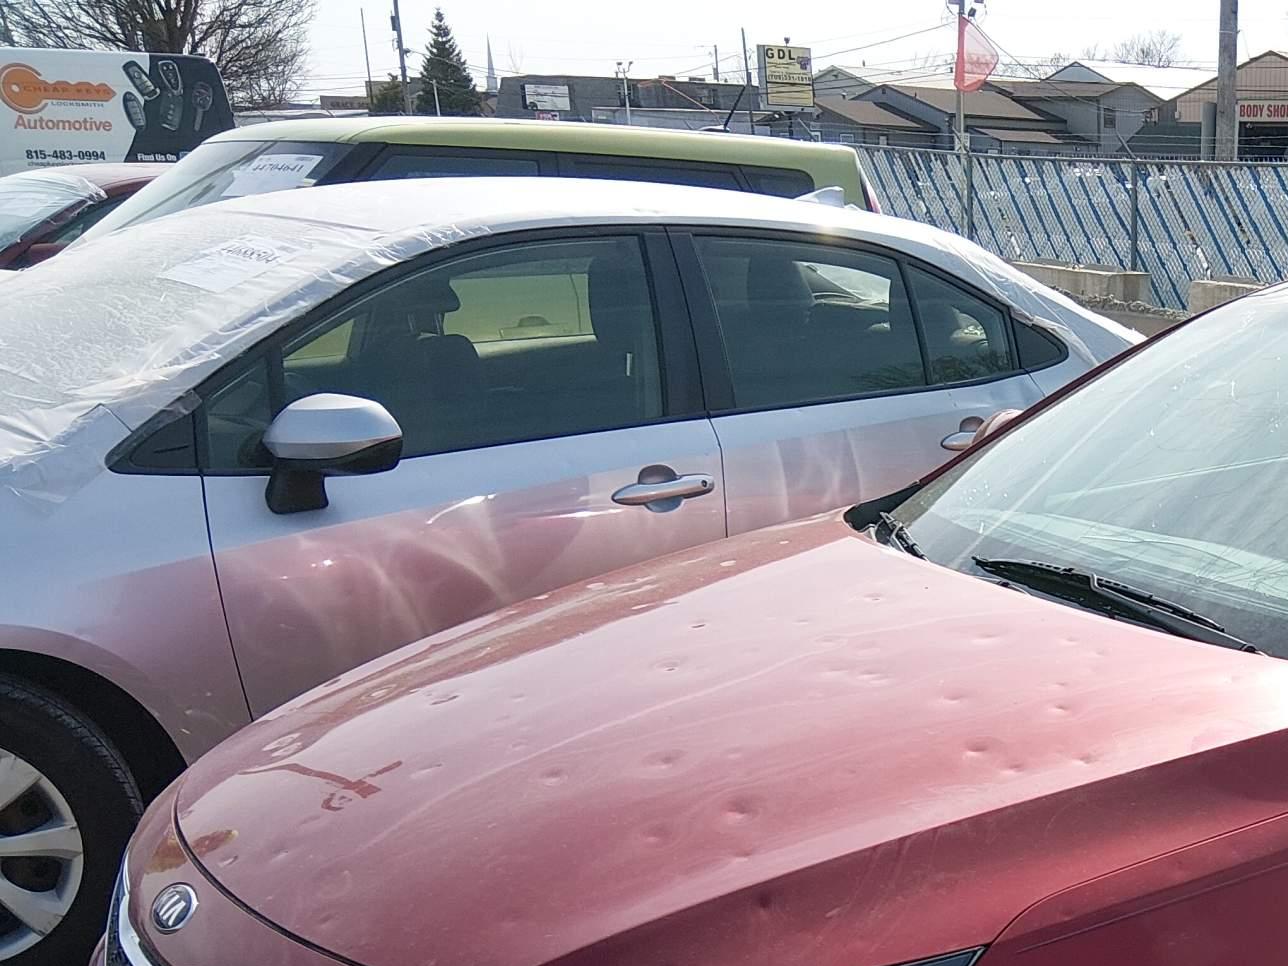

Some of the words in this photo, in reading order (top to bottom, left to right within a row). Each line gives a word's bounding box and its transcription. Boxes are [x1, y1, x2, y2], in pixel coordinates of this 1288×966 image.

[51, 101, 105, 109] LOCKSMITH
[1239, 104, 1265, 118] BODY
[14, 115, 113, 132] Automotive
[25, 149, 107, 161] 815-483-0994
[137, 153, 155, 162] Find
[155, 154, 166, 162] Us
[166, 154, 178, 162] On
